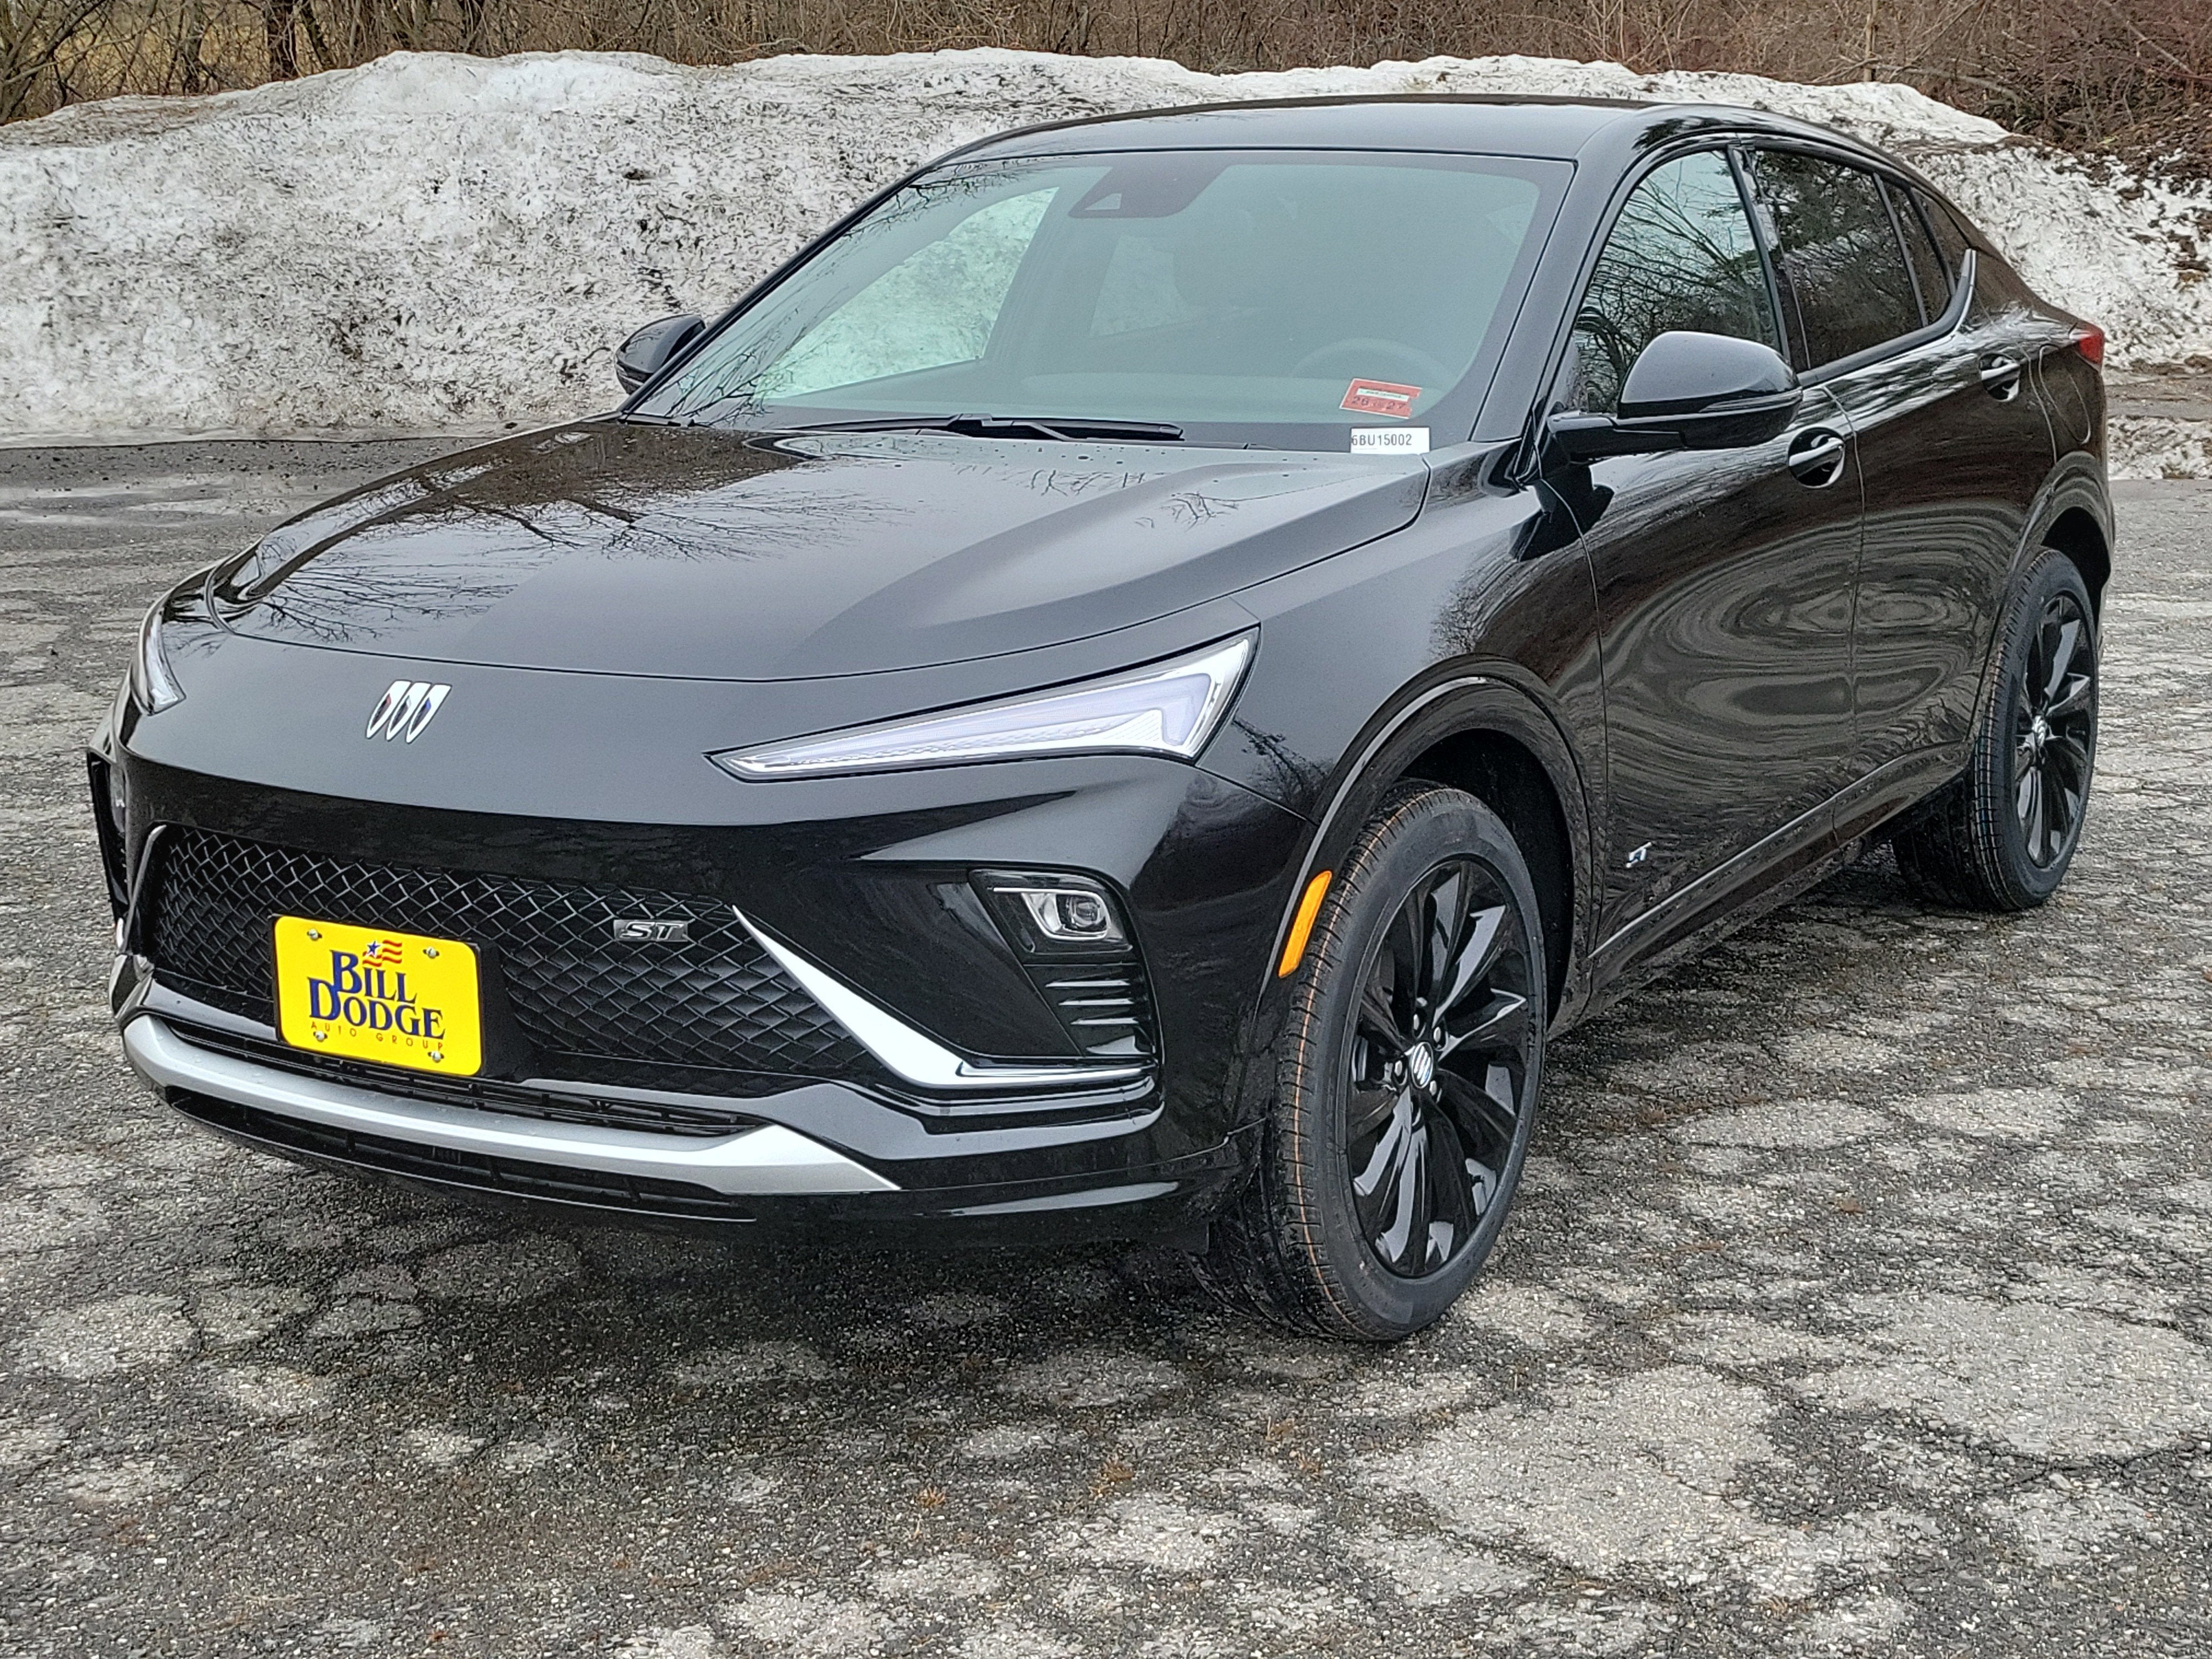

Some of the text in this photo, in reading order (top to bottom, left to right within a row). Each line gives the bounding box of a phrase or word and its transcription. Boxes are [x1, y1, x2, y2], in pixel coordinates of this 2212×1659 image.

[1386, 401, 1406, 410] 27
[1351, 433, 1412, 446] 6BU15002
[619, 921, 685, 940] ST
[330, 950, 417, 1004] BILL
[307, 977, 445, 1040] DODGE
[311, 1022, 443, 1051] AUTO GROUP
